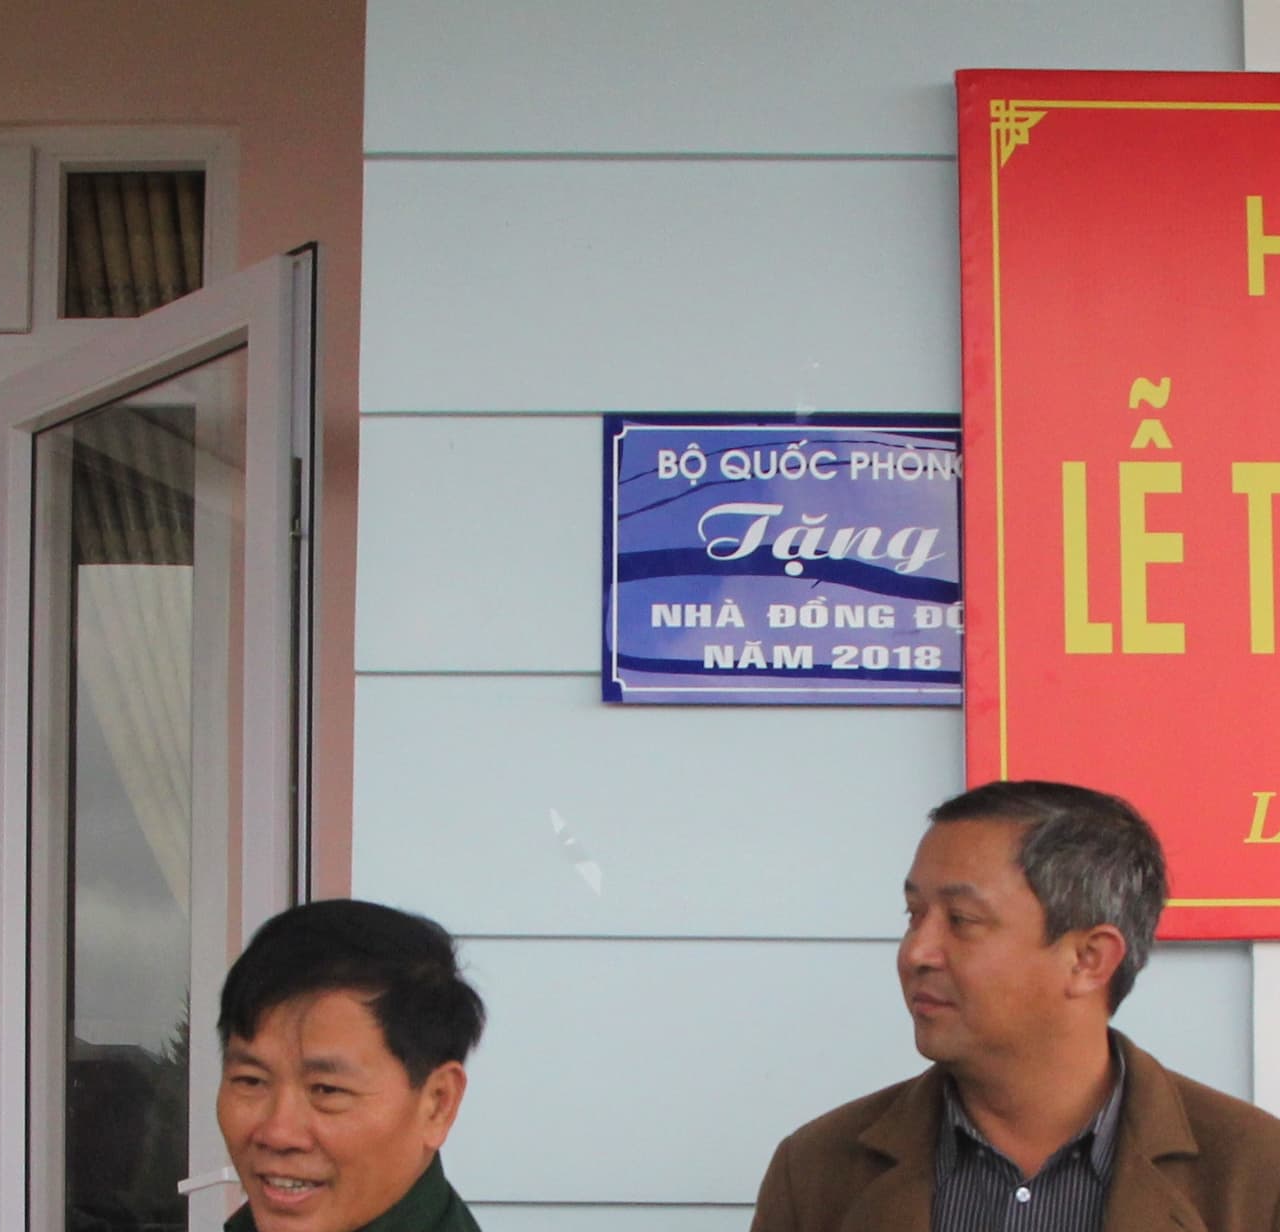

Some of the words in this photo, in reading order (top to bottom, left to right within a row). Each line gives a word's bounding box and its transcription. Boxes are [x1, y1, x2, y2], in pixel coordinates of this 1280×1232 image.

[658, 442, 707, 486] BỘ
[720, 439, 837, 481] QUỐC
[697, 502, 946, 577] Tặng
[1060, 376, 1188, 656] LỄ
[651, 598, 744, 629] NHÀ
[913, 601, 963, 635] ĐỘ
[704, 640, 814, 670] NĂM
[831, 645, 942, 670] 2018
